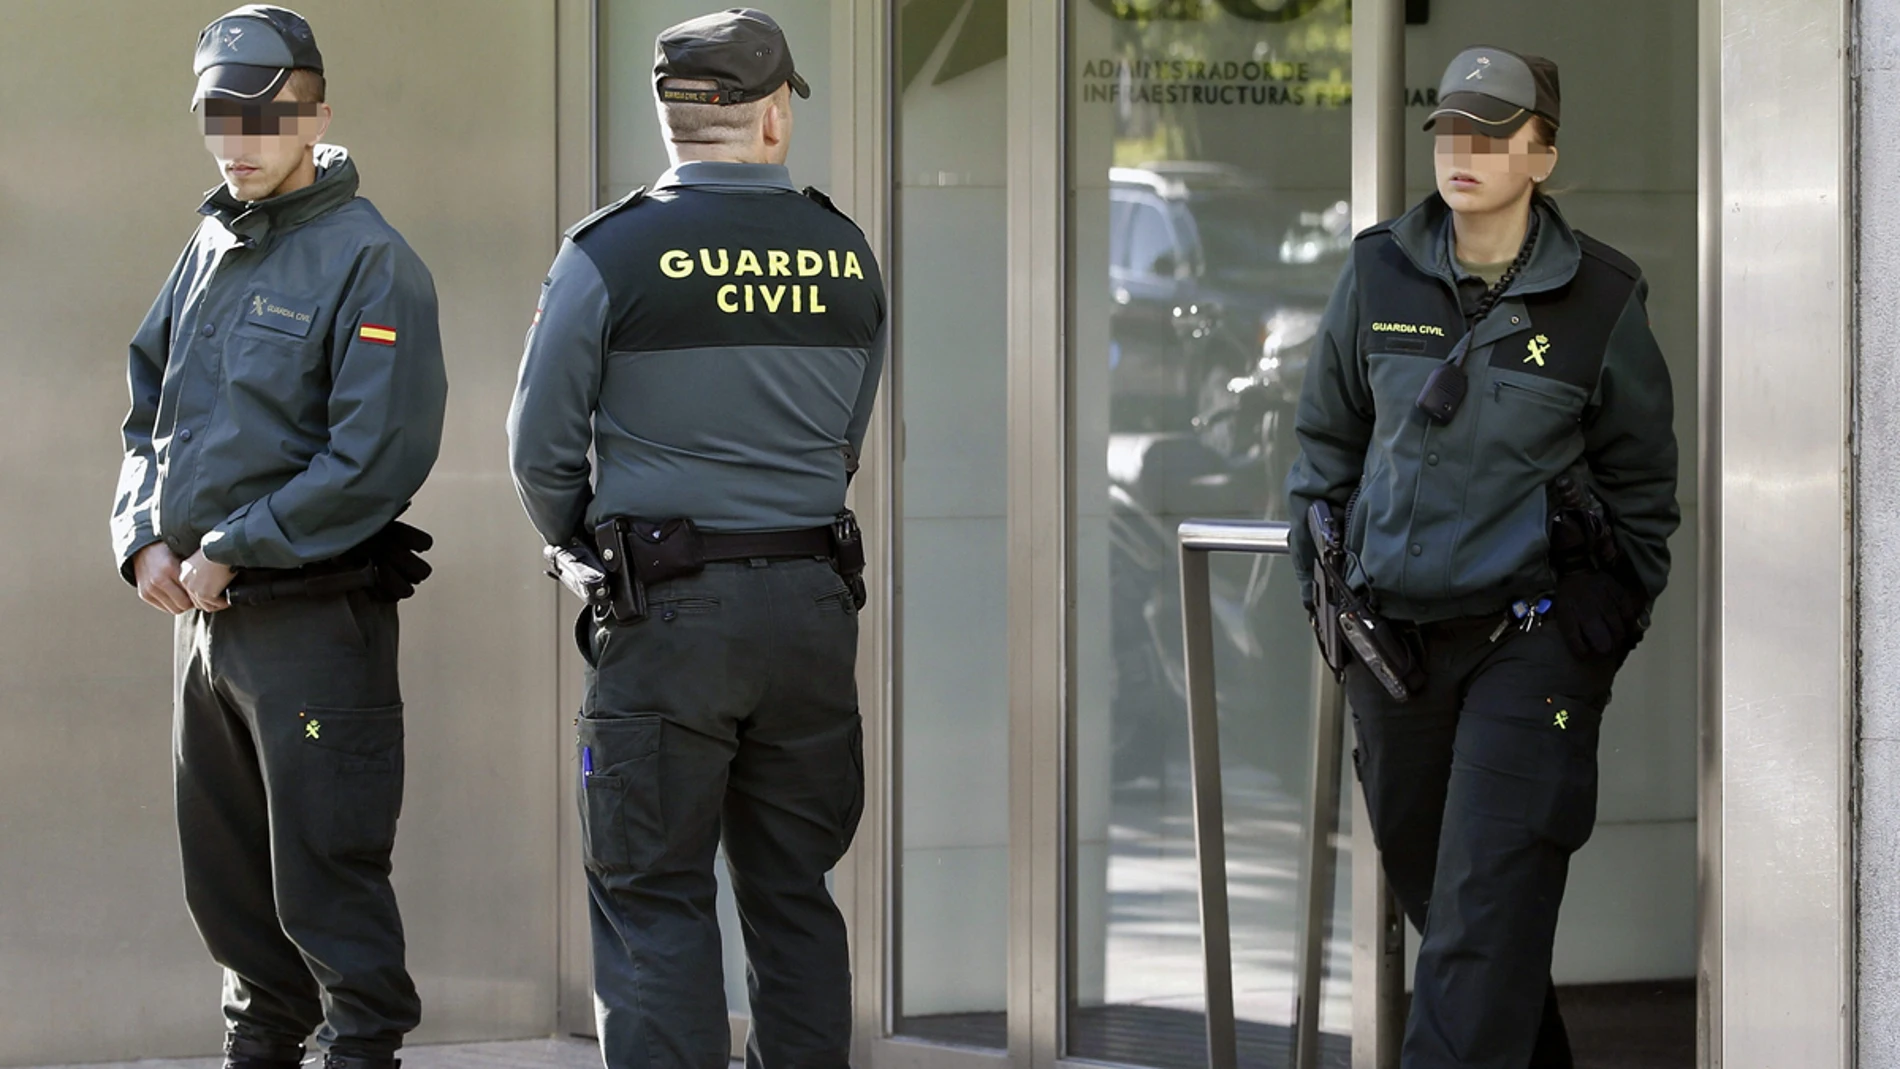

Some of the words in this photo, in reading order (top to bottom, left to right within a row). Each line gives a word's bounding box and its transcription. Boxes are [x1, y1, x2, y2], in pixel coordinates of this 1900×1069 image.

[1282, 61, 1309, 82] DE
[1083, 83, 1305, 106] INFAESTRUCTURAS
[659, 248, 864, 280] GUARDIA
[716, 283, 827, 314] CIVIL
[266, 303, 294, 318] GUARDIA
[295, 312, 311, 324] CIVIL
[1372, 322, 1418, 333] GUARDIA
[1419, 325, 1445, 337] CIVIL
